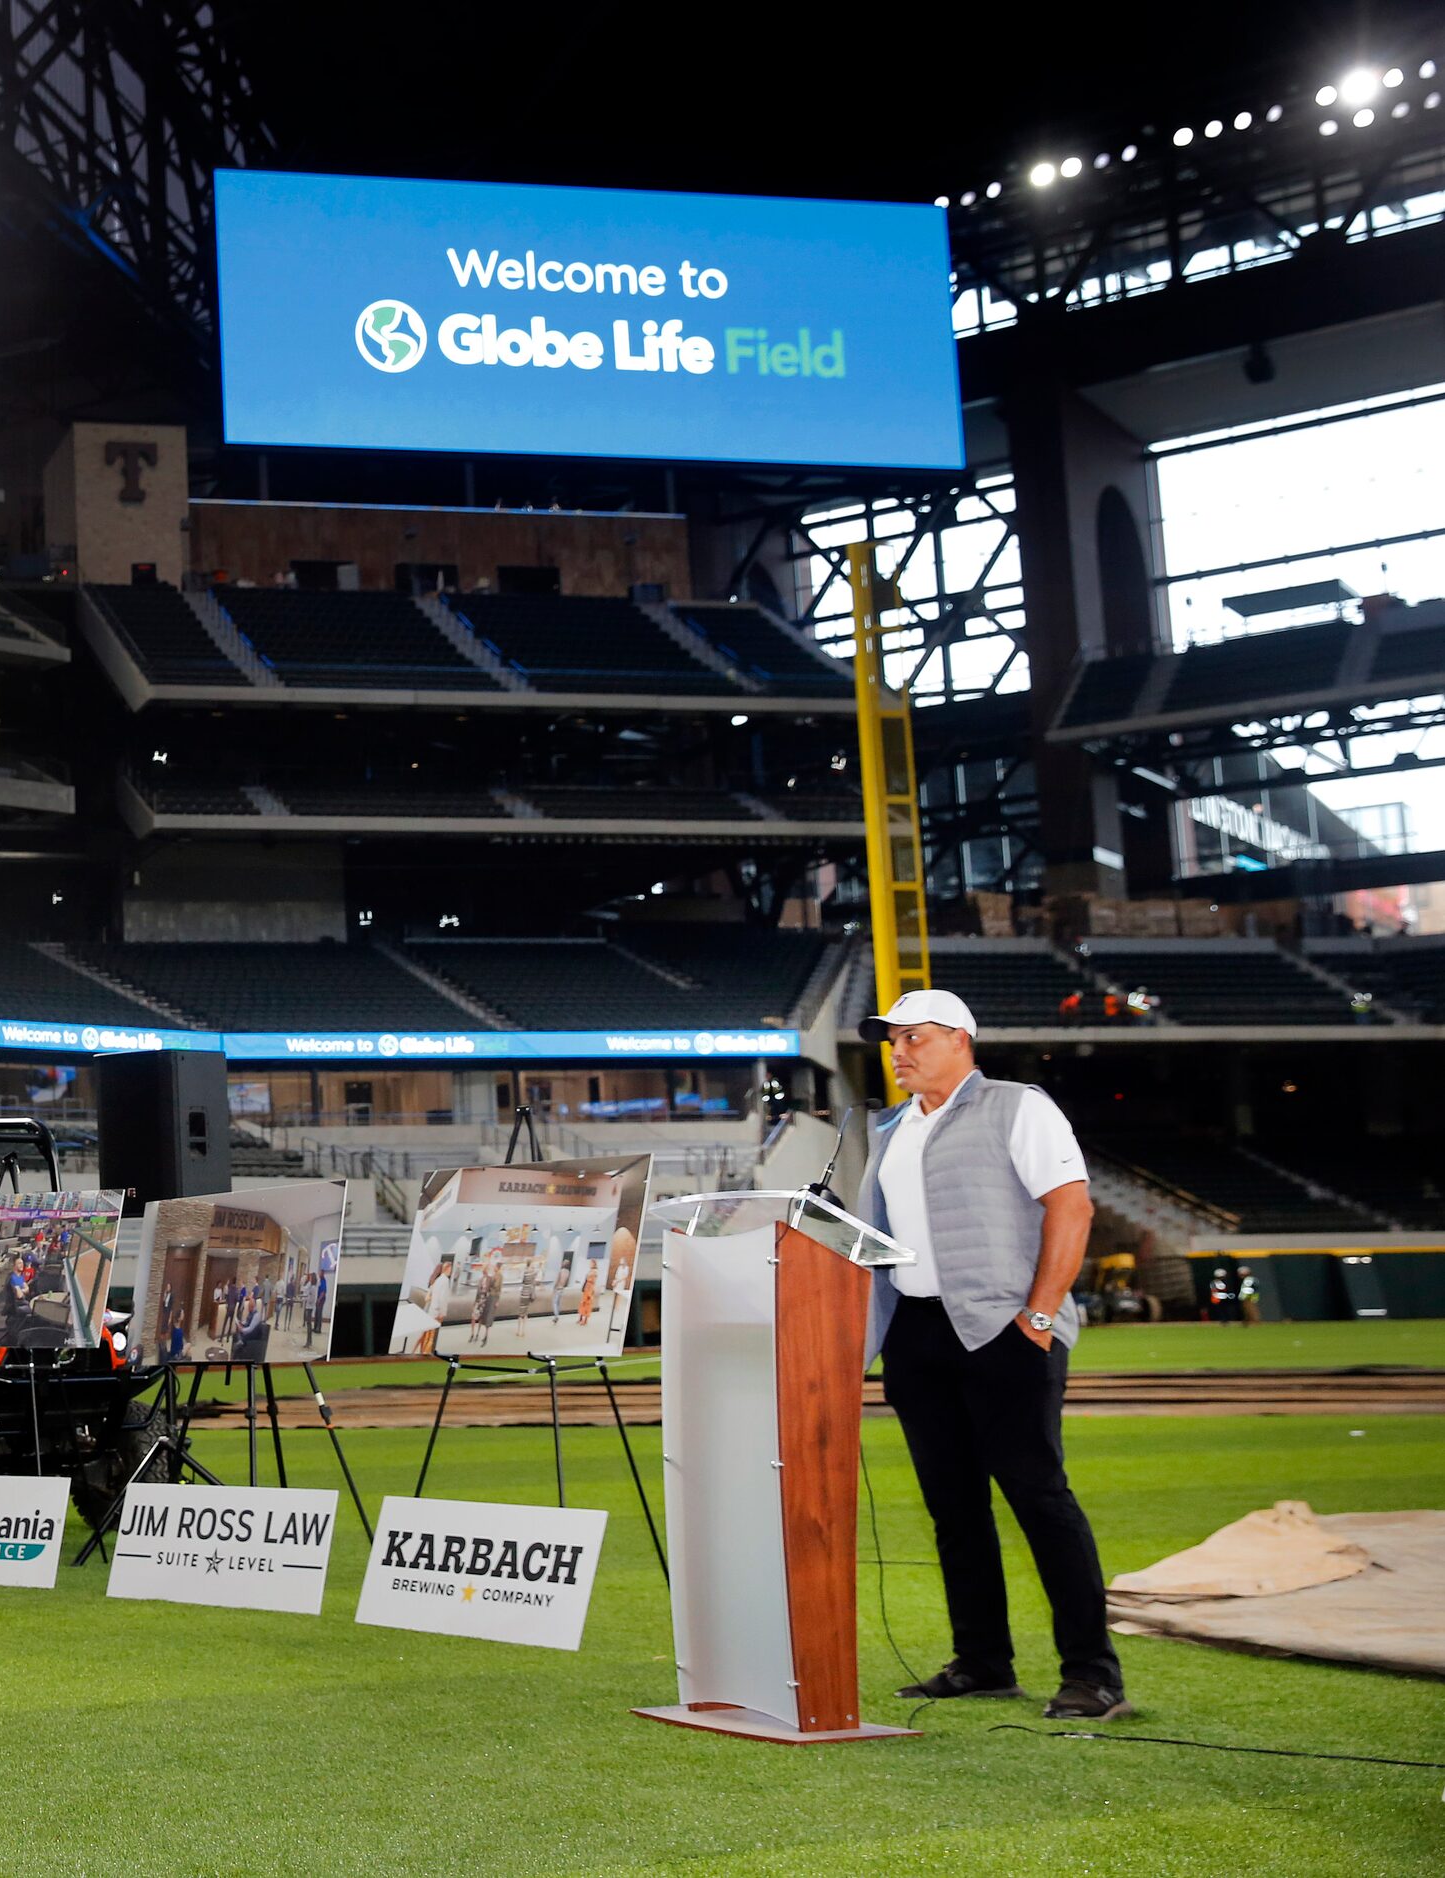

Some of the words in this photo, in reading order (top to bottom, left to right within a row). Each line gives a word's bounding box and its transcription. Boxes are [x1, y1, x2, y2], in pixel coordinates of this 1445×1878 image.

[446, 247, 666, 296] Welcome
[679, 260, 728, 299] to
[438, 313, 604, 370] Globe
[613, 319, 715, 375] Life
[724, 326, 846, 378] Field
[104, 441, 157, 503] T
[2, 1026, 62, 1044] Welcome
[63, 1030, 78, 1044] to
[100, 1030, 138, 1049] Globe
[138, 1032, 163, 1051] Life
[286, 1038, 355, 1053] Welcome
[357, 1038, 374, 1052] to
[399, 1036, 445, 1054] Globe
[445, 1036, 475, 1053] Life
[606, 1036, 673, 1051] Welcome
[673, 1037, 691, 1051] to
[120, 1505, 169, 1537] JIM
[177, 1507, 255, 1542] ROSS
[263, 1511, 331, 1546] LAW
[156, 1551, 199, 1567] SUITE
[228, 1556, 275, 1573] LEVEL
[381, 1530, 584, 1585] KARBACH
[392, 1578, 455, 1596] BREWING
[482, 1588, 554, 1607] COMPANY
